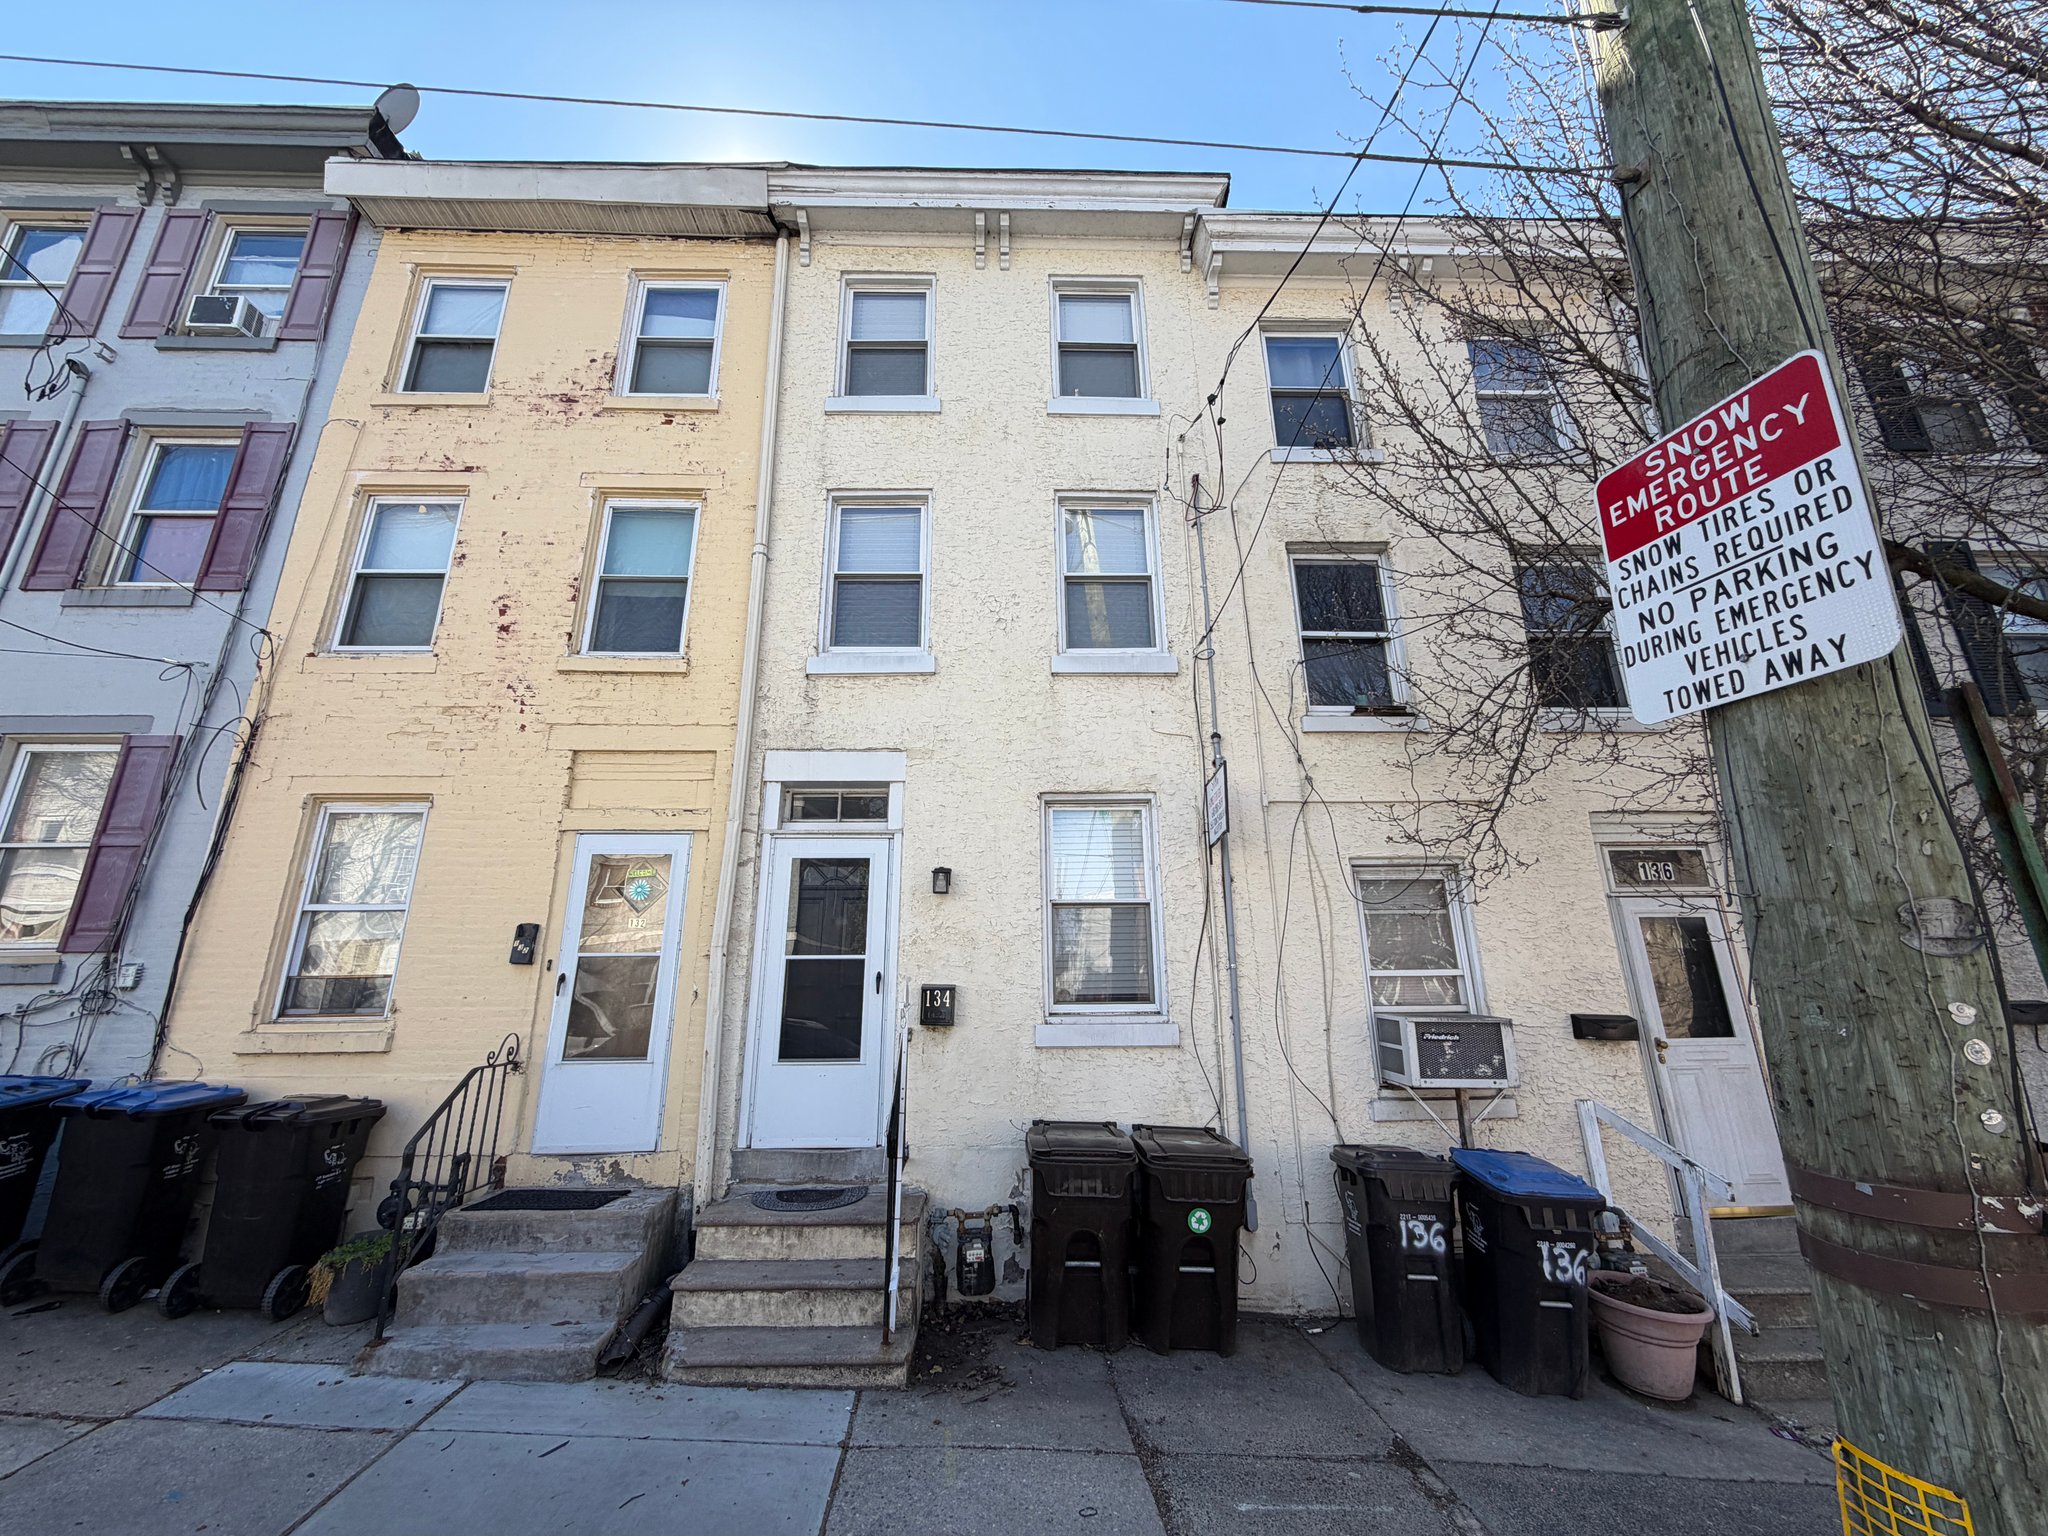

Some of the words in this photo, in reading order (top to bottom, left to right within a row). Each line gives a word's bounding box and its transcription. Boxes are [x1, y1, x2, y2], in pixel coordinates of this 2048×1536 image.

[1608, 392, 1811, 528] EMERGENCY
[1644, 394, 1751, 477] SNOW
[1618, 532, 1682, 581] SNOW
[1697, 488, 1775, 543] TIRES
[1794, 458, 1837, 496] OR
[1654, 454, 1769, 533] ROUTE
[1617, 555, 1700, 610] CHAINS
[1713, 485, 1852, 567] REQUIRED
[1638, 601, 1675, 634] NO
[1690, 531, 1840, 613] PARKING
[1624, 620, 1701, 668] DURING
[1715, 550, 1874, 635] EMERGENCY
[1684, 614, 1808, 676] VEHICLES
[1663, 669, 1745, 714] TOWED
[1765, 633, 1848, 686] AWAY
[1640, 863, 1672, 879] 136
[629, 919, 646, 927] 132
[926, 990, 950, 1007] 134
[1400, 1220, 1446, 1252] 136
[1540, 1247, 1590, 1285] 136
